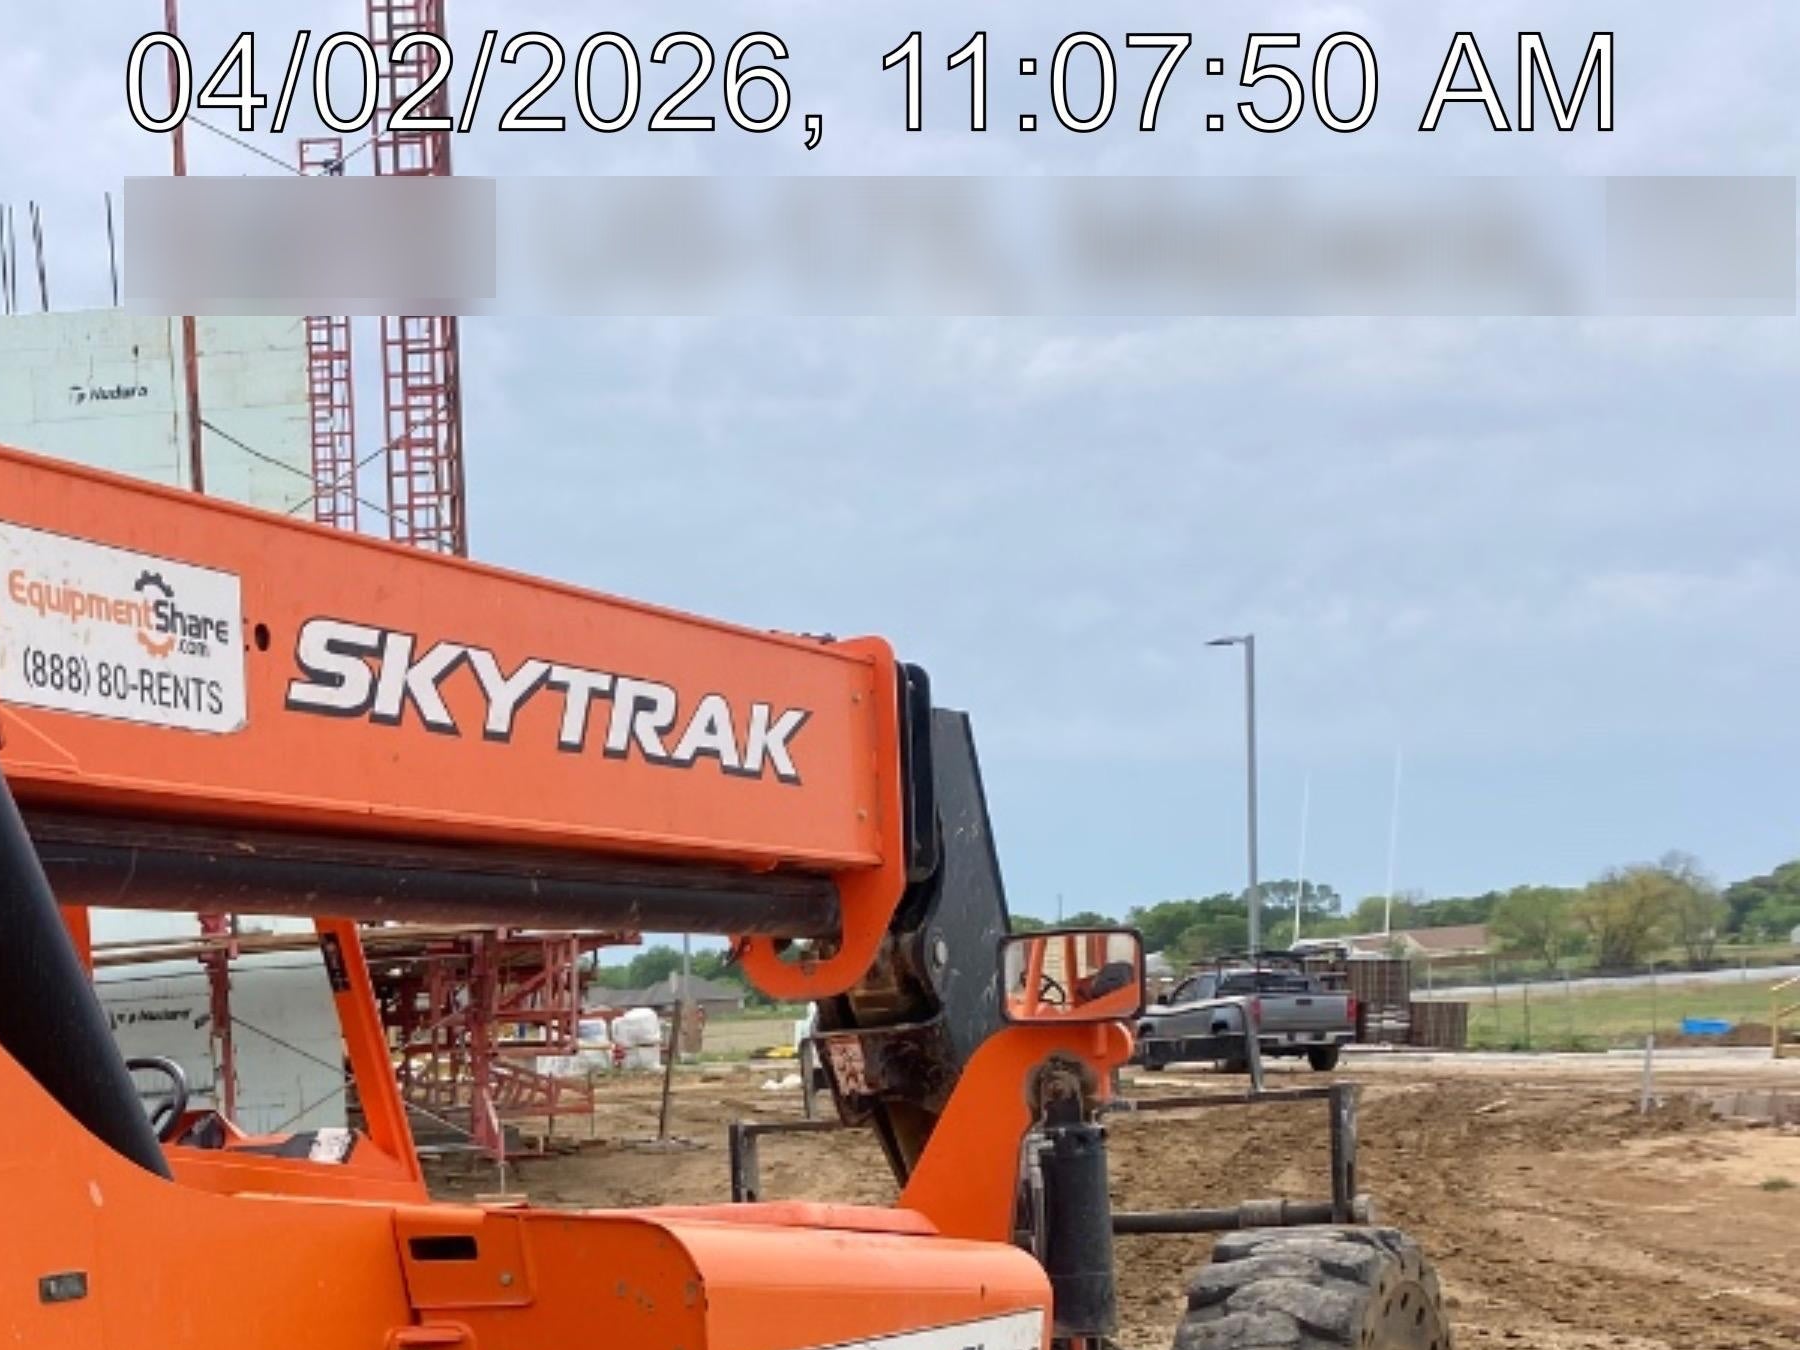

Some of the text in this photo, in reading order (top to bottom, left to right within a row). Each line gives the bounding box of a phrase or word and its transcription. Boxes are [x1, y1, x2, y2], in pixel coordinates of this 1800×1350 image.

[8, 569, 229, 645] EquipmentShare
[23, 646, 224, 715] (888) 80-RENTS
[285, 615, 812, 784] SKYTRAK
